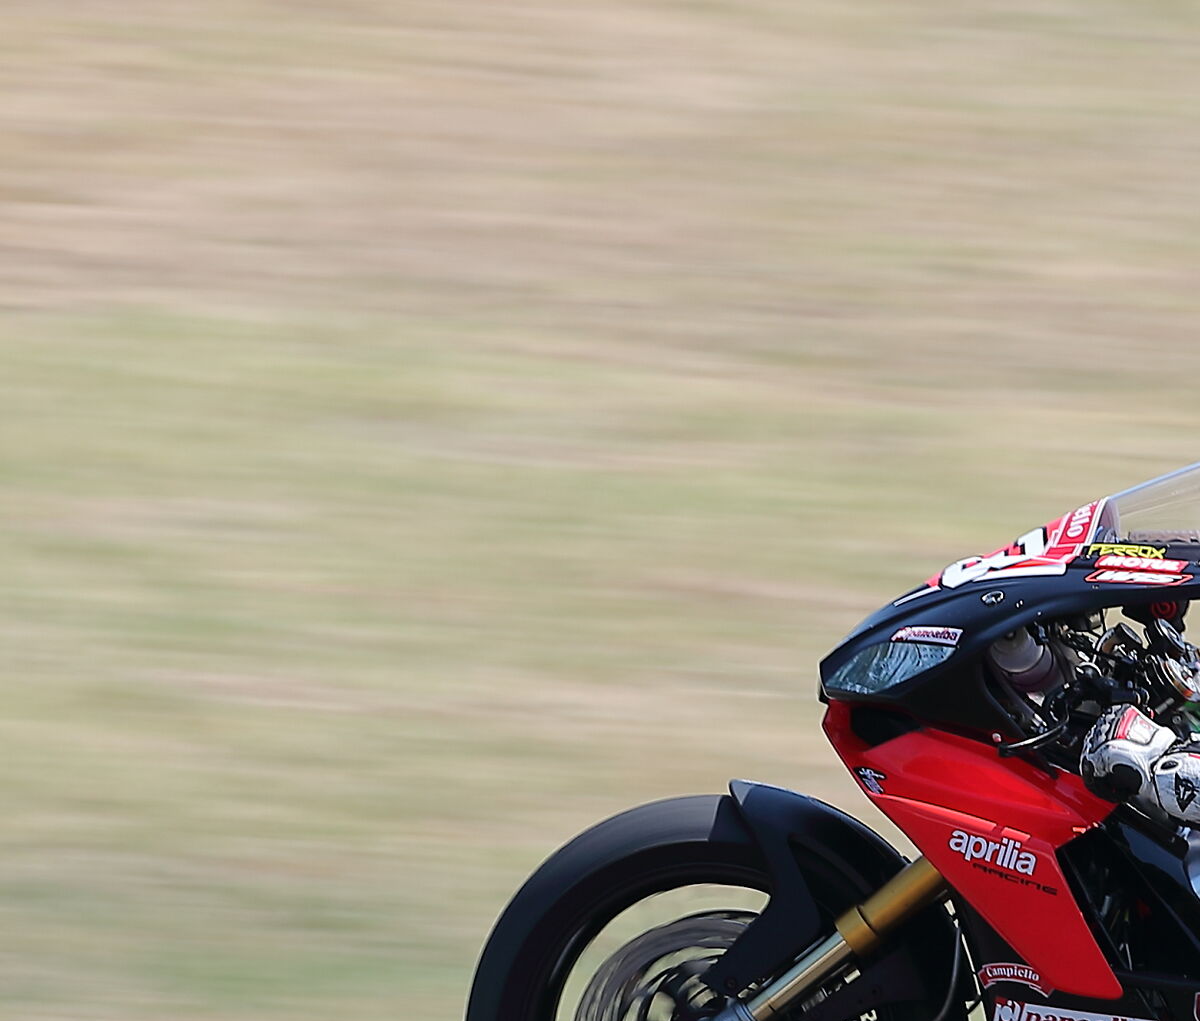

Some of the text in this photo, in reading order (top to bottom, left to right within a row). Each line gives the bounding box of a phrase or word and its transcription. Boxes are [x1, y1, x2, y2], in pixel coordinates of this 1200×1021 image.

[1100, 555, 1180, 571] MOTUL
[949, 830, 1037, 876] aprilia
[986, 965, 1040, 981] Campiello
